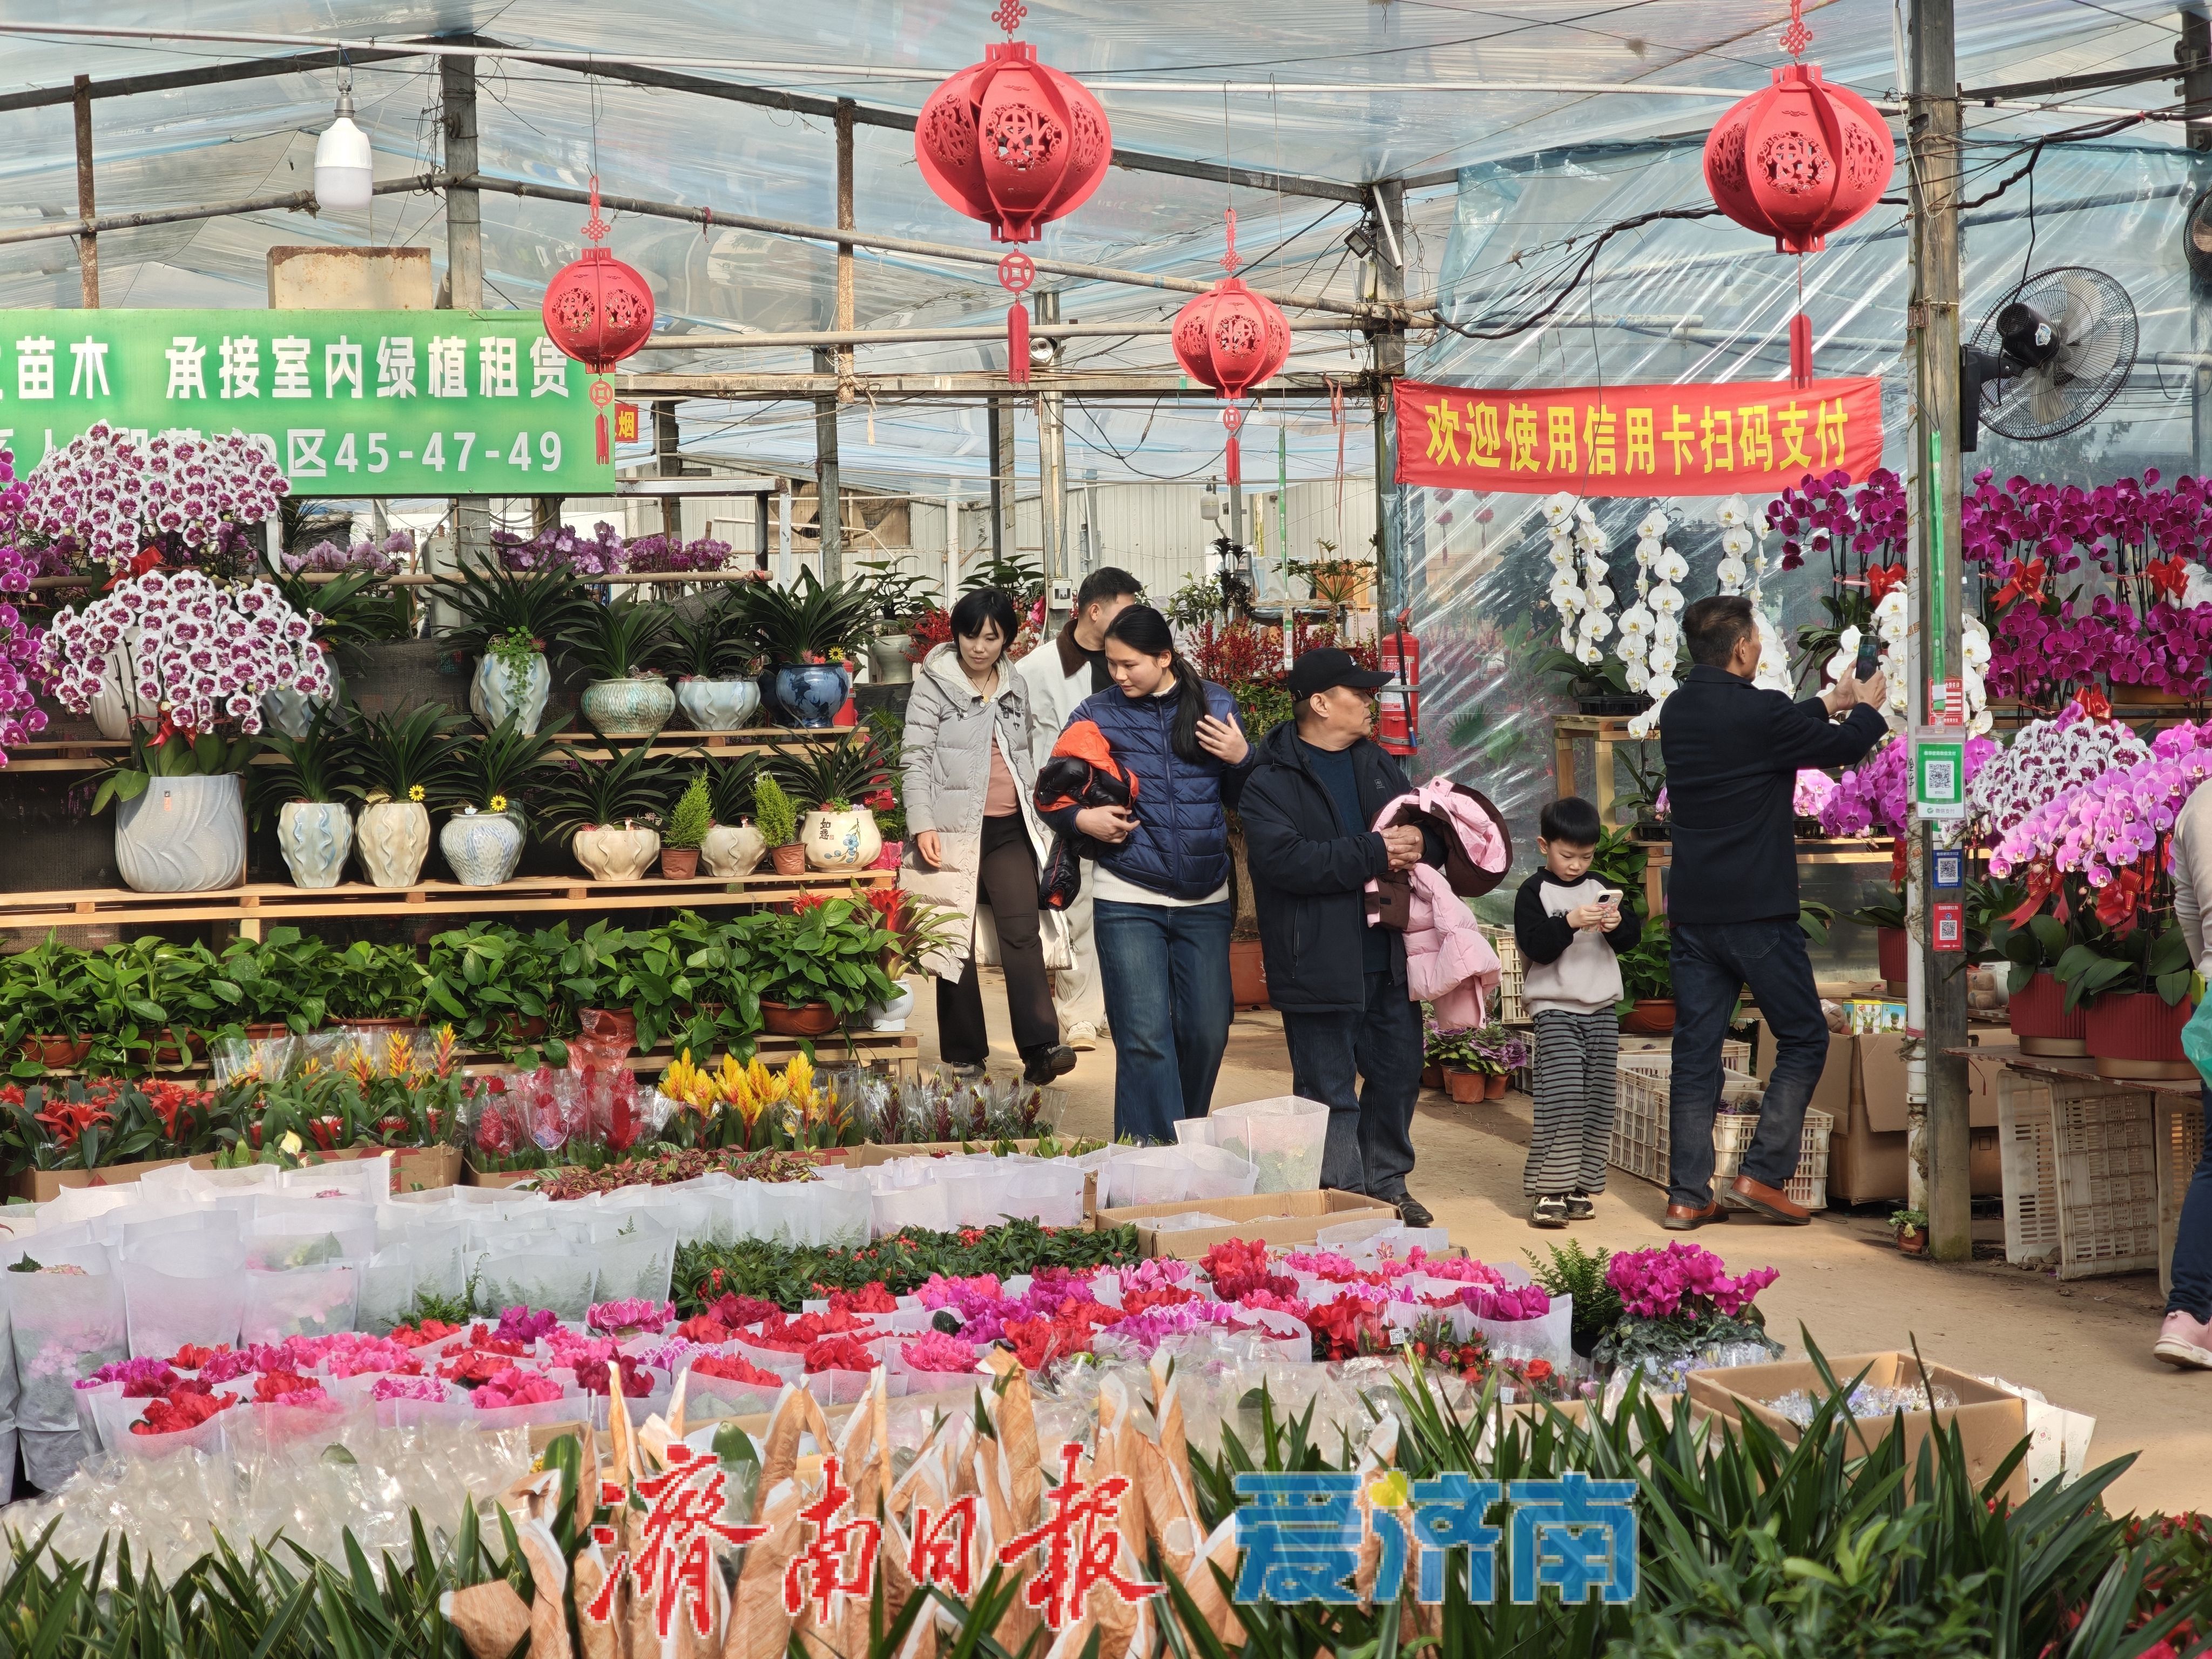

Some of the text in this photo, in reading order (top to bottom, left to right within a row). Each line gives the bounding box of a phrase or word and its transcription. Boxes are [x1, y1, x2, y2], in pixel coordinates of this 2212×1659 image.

[0, 335, 569, 399] 苗木 承接室内绿植租赁
[615, 410, 635, 439] 烟
[1426, 397, 1849, 475] 欢迎使用信用卡扫码支付
[819, 818, 831, 840] 如意
